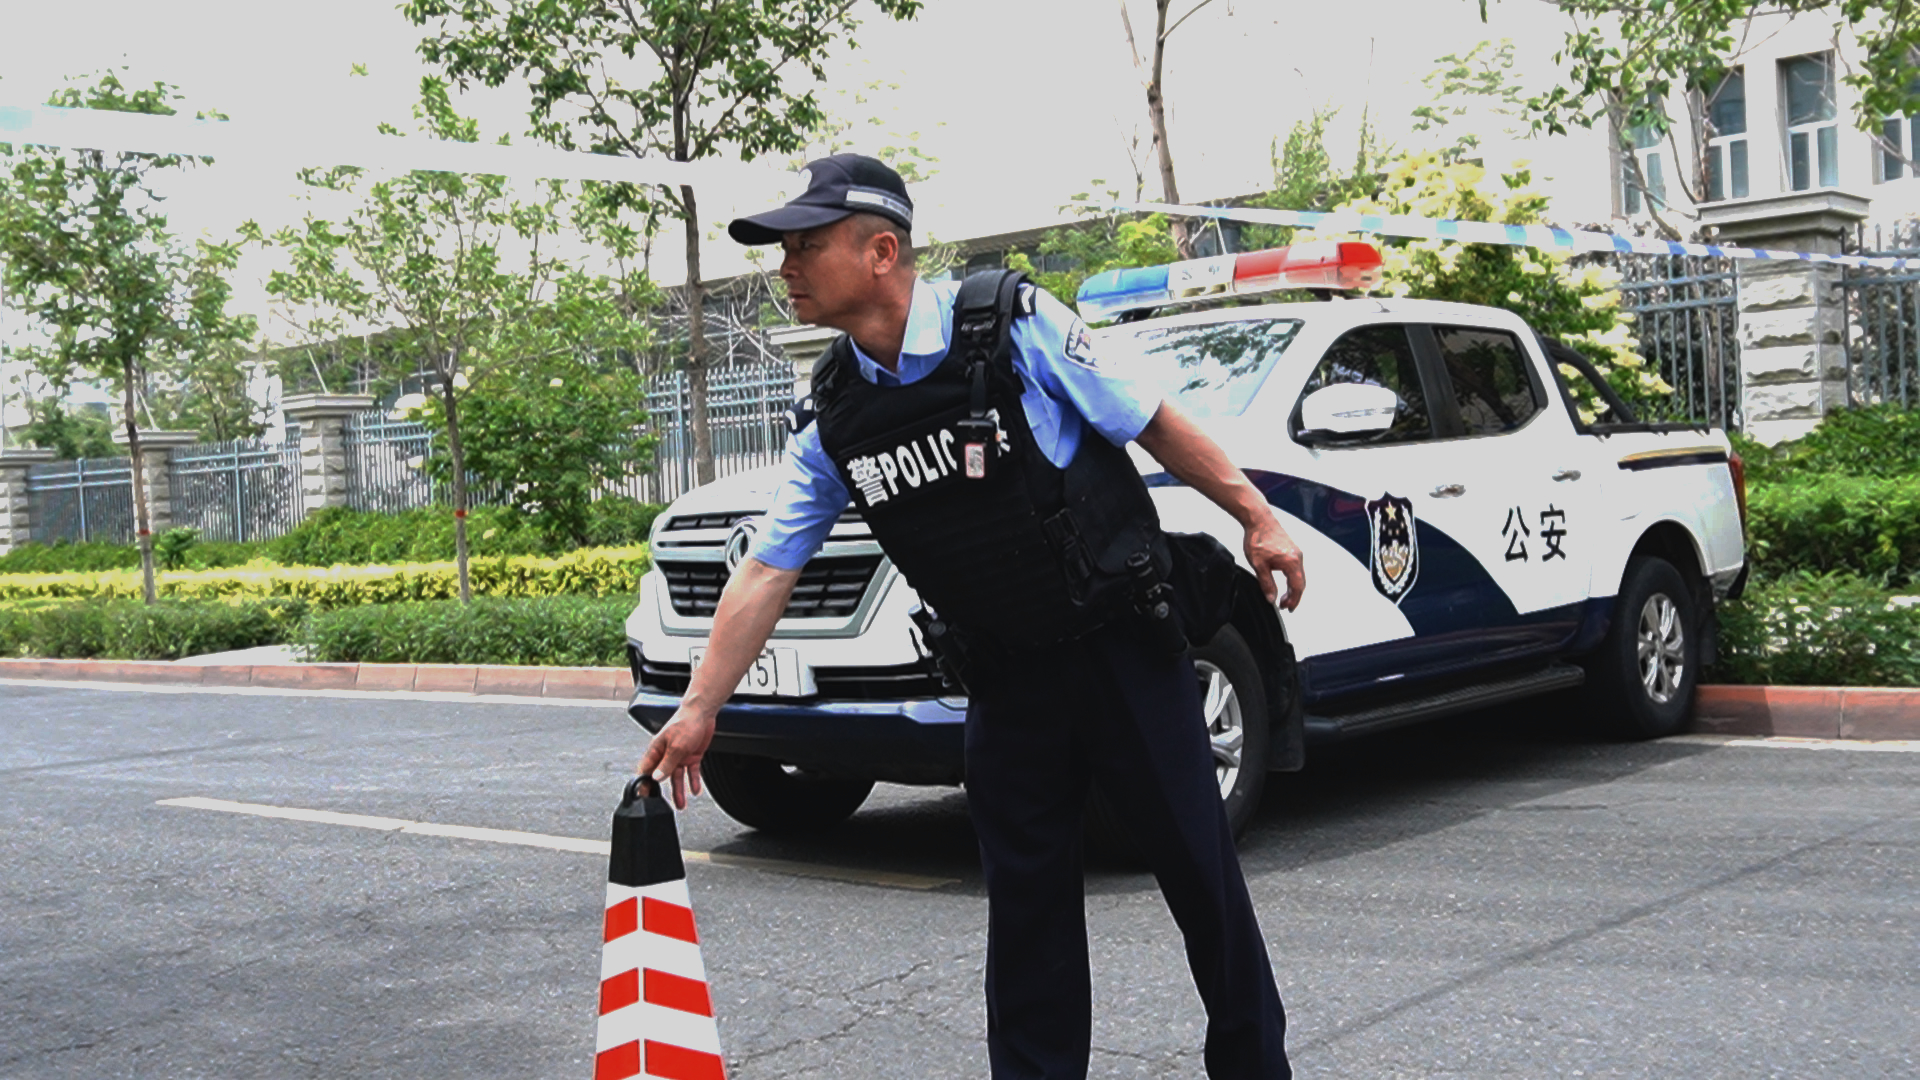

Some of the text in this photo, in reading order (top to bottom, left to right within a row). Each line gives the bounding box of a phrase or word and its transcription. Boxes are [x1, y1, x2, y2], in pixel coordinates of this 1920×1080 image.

[847, 455, 889, 507] 警
[877, 428, 958, 495] POLIC
[1501, 503, 1567, 563] 公安
